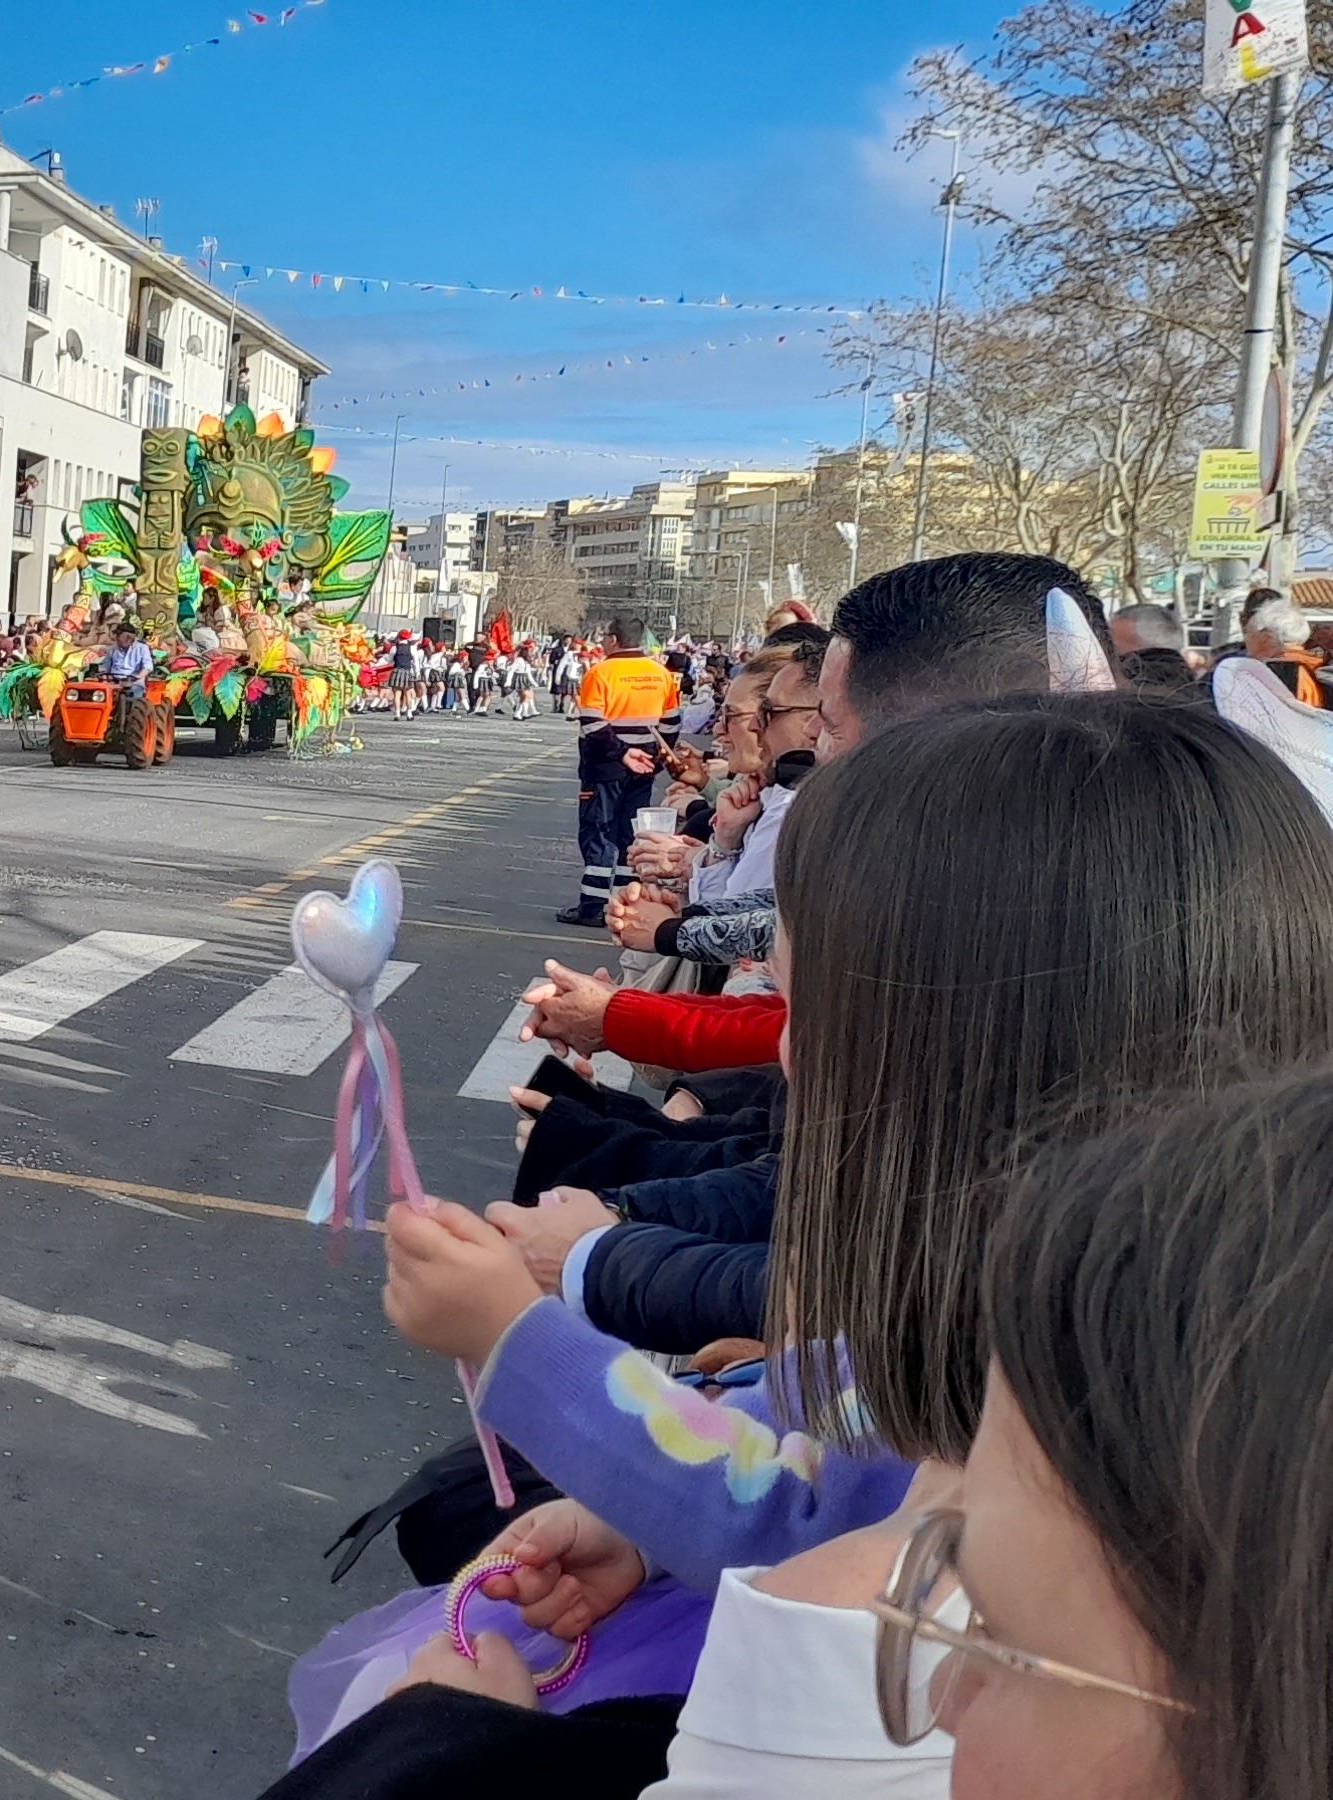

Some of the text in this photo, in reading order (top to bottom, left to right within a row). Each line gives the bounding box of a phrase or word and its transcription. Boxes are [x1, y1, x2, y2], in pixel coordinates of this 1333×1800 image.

[1203, 482, 1238, 490] CALLES
[1199, 543, 1263, 552] EN TU MANO
